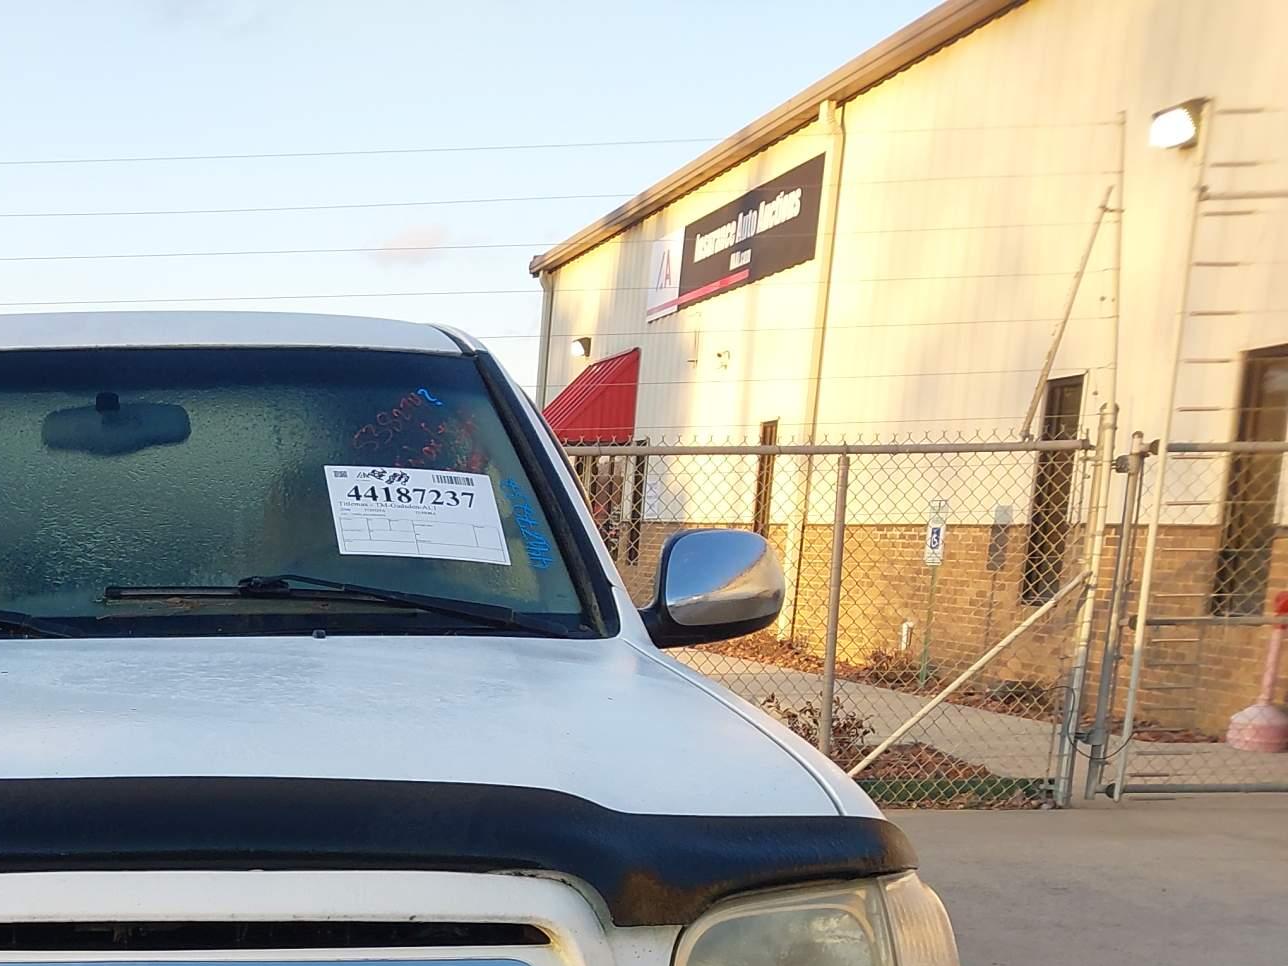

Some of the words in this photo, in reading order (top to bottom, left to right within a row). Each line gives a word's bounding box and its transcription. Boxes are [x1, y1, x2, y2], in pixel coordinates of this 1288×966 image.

[693, 220, 737, 264] Insurance
[735, 209, 758, 244] Auto
[756, 188, 802, 234] Auctions
[346, 485, 475, 508] 44187237
